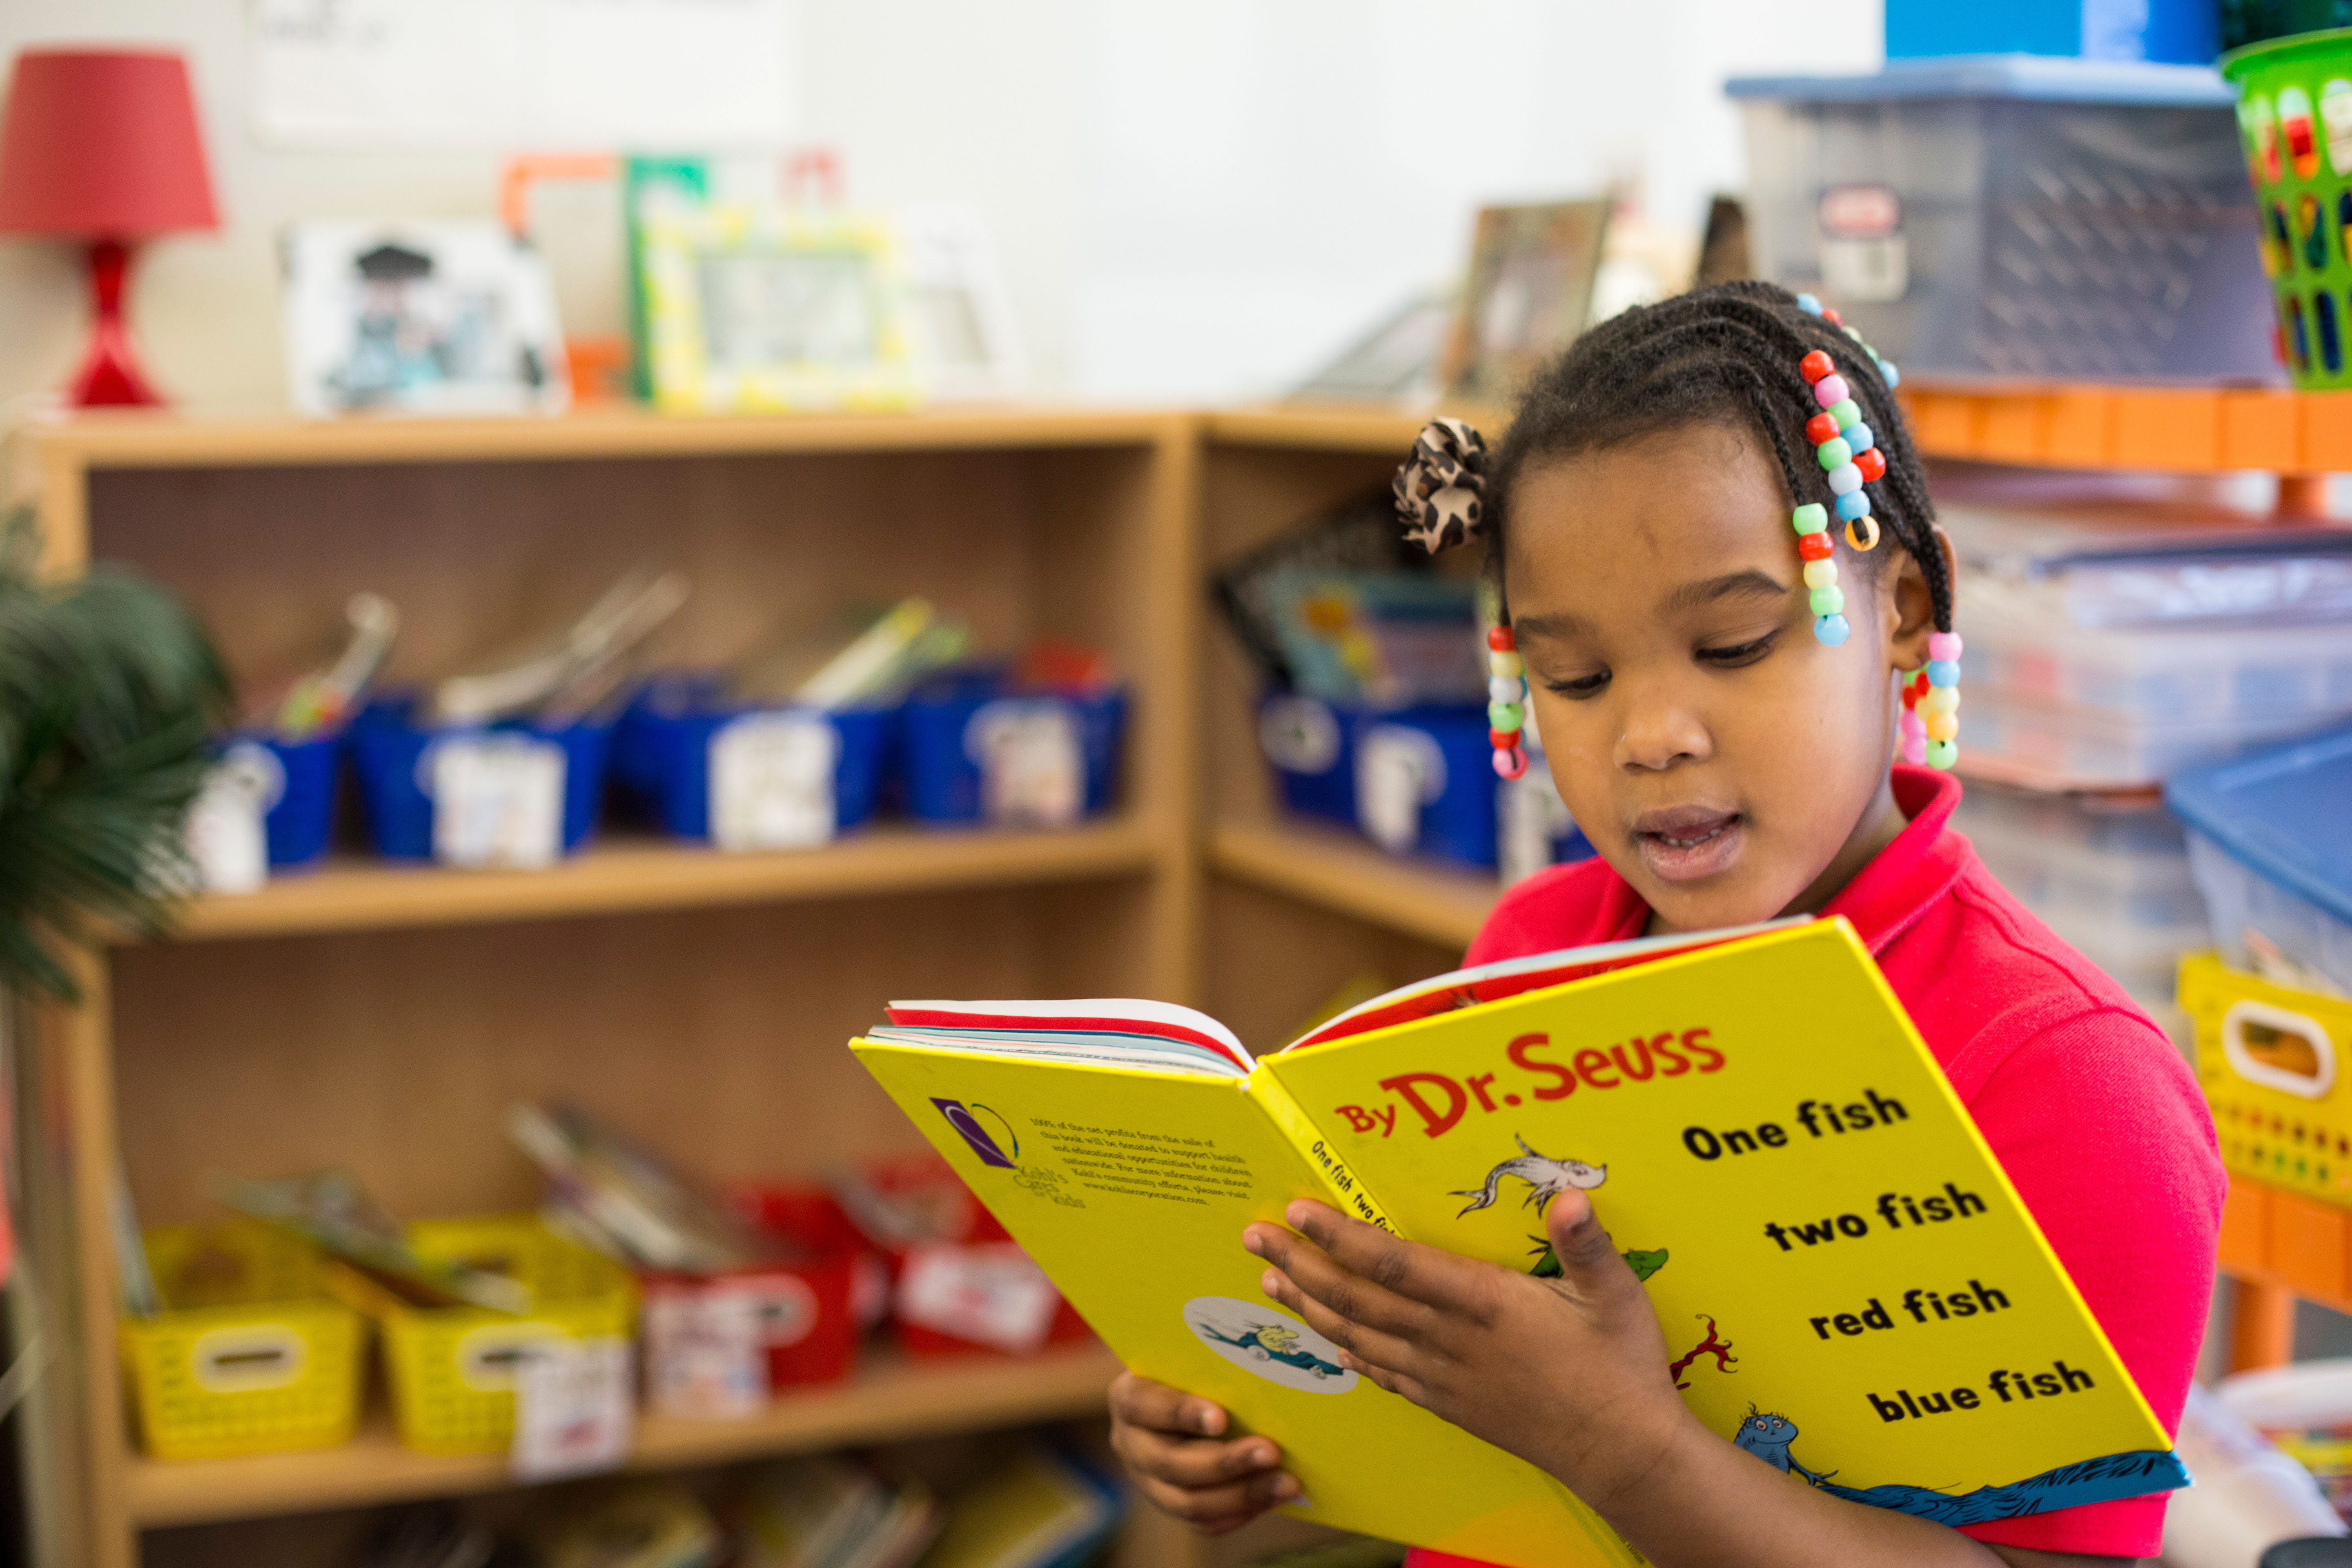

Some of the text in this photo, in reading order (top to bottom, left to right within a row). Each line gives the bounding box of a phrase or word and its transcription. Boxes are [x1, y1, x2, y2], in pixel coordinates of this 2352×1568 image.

[1334, 1027, 1726, 1138] By Dr. Seuss
[1040, 1131, 1060, 1140] this
[1058, 1132, 1084, 1143] book
[1085, 1137, 1104, 1146] will
[1103, 1138, 1118, 1147] be
[1118, 1140, 1158, 1152] donated
[1158, 1146, 1170, 1154] to
[1171, 1149, 1212, 1159] support
[1067, 1123, 1086, 1131] the
[1104, 1128, 1136, 1138] profits
[1136, 1131, 1161, 1141] from
[1162, 1134, 1181, 1143] the
[1204, 1139, 1215, 1148] of
[1682, 1089, 1909, 1161] One fish
[1051, 1145, 1252, 1177] and educational opportunities for children
[1103, 1174, 1156, 1188] community
[1192, 1185, 1226, 1196] please
[1115, 1163, 1134, 1172] For
[1135, 1167, 1162, 1176] more
[1160, 1169, 1222, 1184] information
[1312, 1140, 1395, 1234] One fish two fi
[1764, 1182, 1987, 1252] two fish
[1809, 1279, 2011, 1341] red fish
[1866, 1360, 2096, 1423] blue fish
